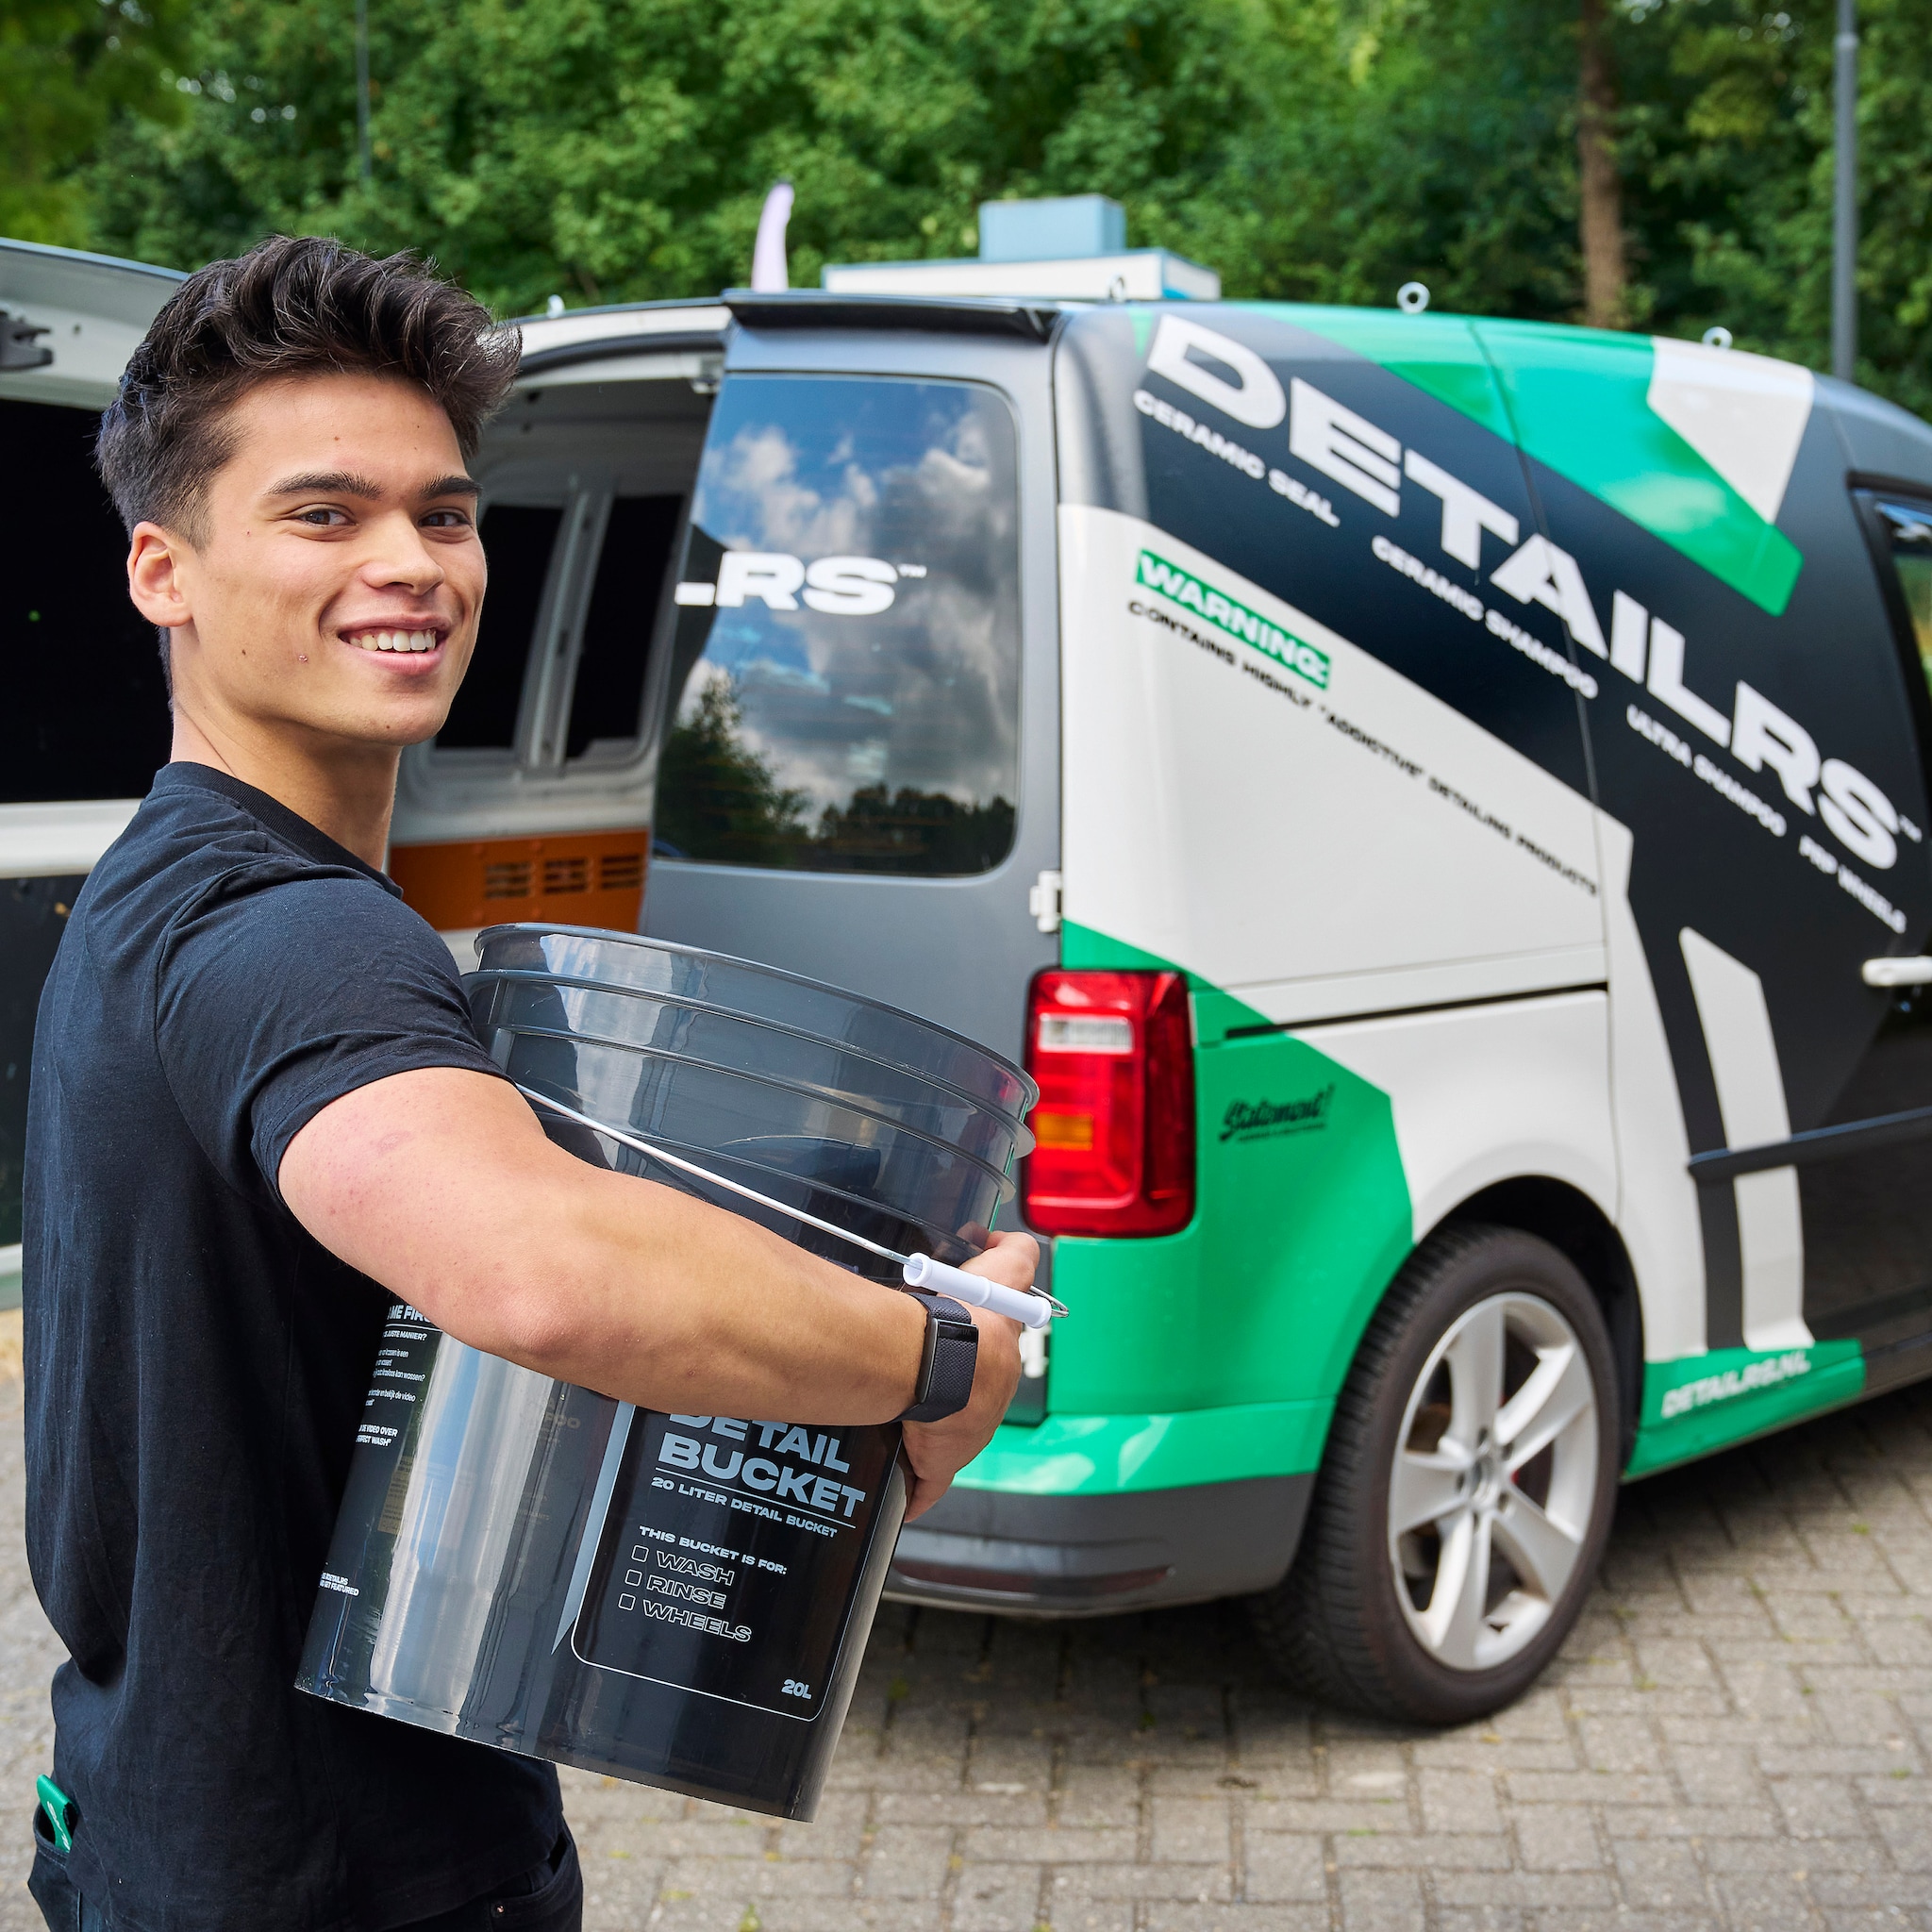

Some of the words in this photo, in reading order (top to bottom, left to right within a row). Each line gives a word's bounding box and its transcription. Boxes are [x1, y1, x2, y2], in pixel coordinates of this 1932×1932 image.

[1133, 389, 1265, 480] CERAMIC
[1268, 468, 1341, 528] SEAL
[1371, 535, 1484, 622] CERAMIC
[1484, 608, 1599, 699] SHAMPOO
[1626, 703, 1692, 769] ULTRA
[1692, 754, 1788, 838] SHAMPOO
[1798, 834, 1839, 875] PRO
[1837, 863, 1907, 934] WHEELS
[1128, 601, 1237, 666] CONTAINS
[1241, 661, 1313, 710] HIGHLY
[1429, 777, 1512, 839] DETAILING
[1516, 834, 1598, 896] PRODUCTS
[401, 1392, 416, 1402] video
[379, 1425, 398, 1438] OVER
[658, 1432, 867, 1518] BUCKET
[651, 1476, 675, 1491] 20
[678, 1483, 728, 1507] LITER
[730, 1497, 783, 1523] DETAIL
[785, 1513, 838, 1539] BUCKET
[639, 1525, 676, 1543] THIS
[678, 1537, 740, 1560] BUCKET
[741, 1554, 756, 1566] IS
[758, 1558, 788, 1575] FOR:
[657, 1550, 735, 1587] WASH
[331, 1582, 359, 1596] FEATURED
[646, 1574, 727, 1609] RINSE
[642, 1598, 753, 1642] WHEELS
[780, 1678, 812, 1699] 20L
